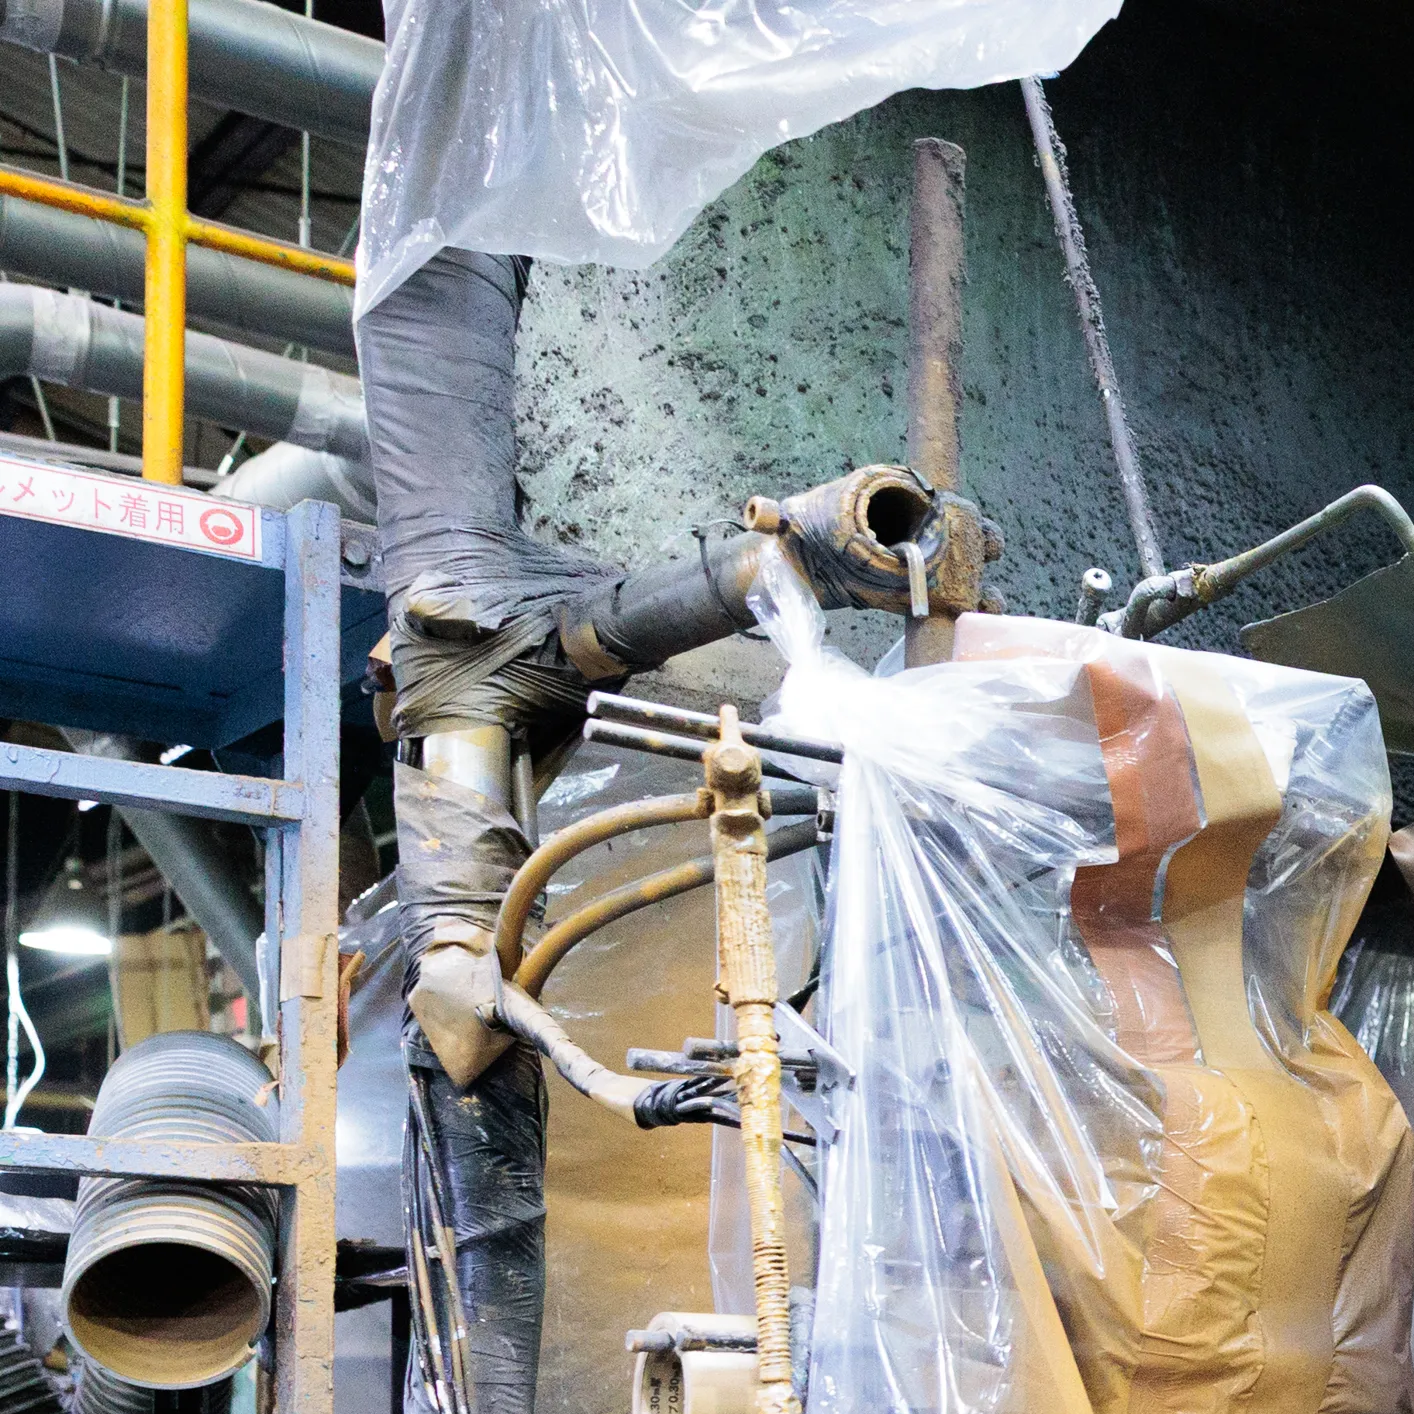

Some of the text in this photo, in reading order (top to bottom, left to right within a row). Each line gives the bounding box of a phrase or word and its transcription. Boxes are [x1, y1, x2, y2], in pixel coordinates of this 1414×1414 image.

[0, 476, 184, 535] メット着用
